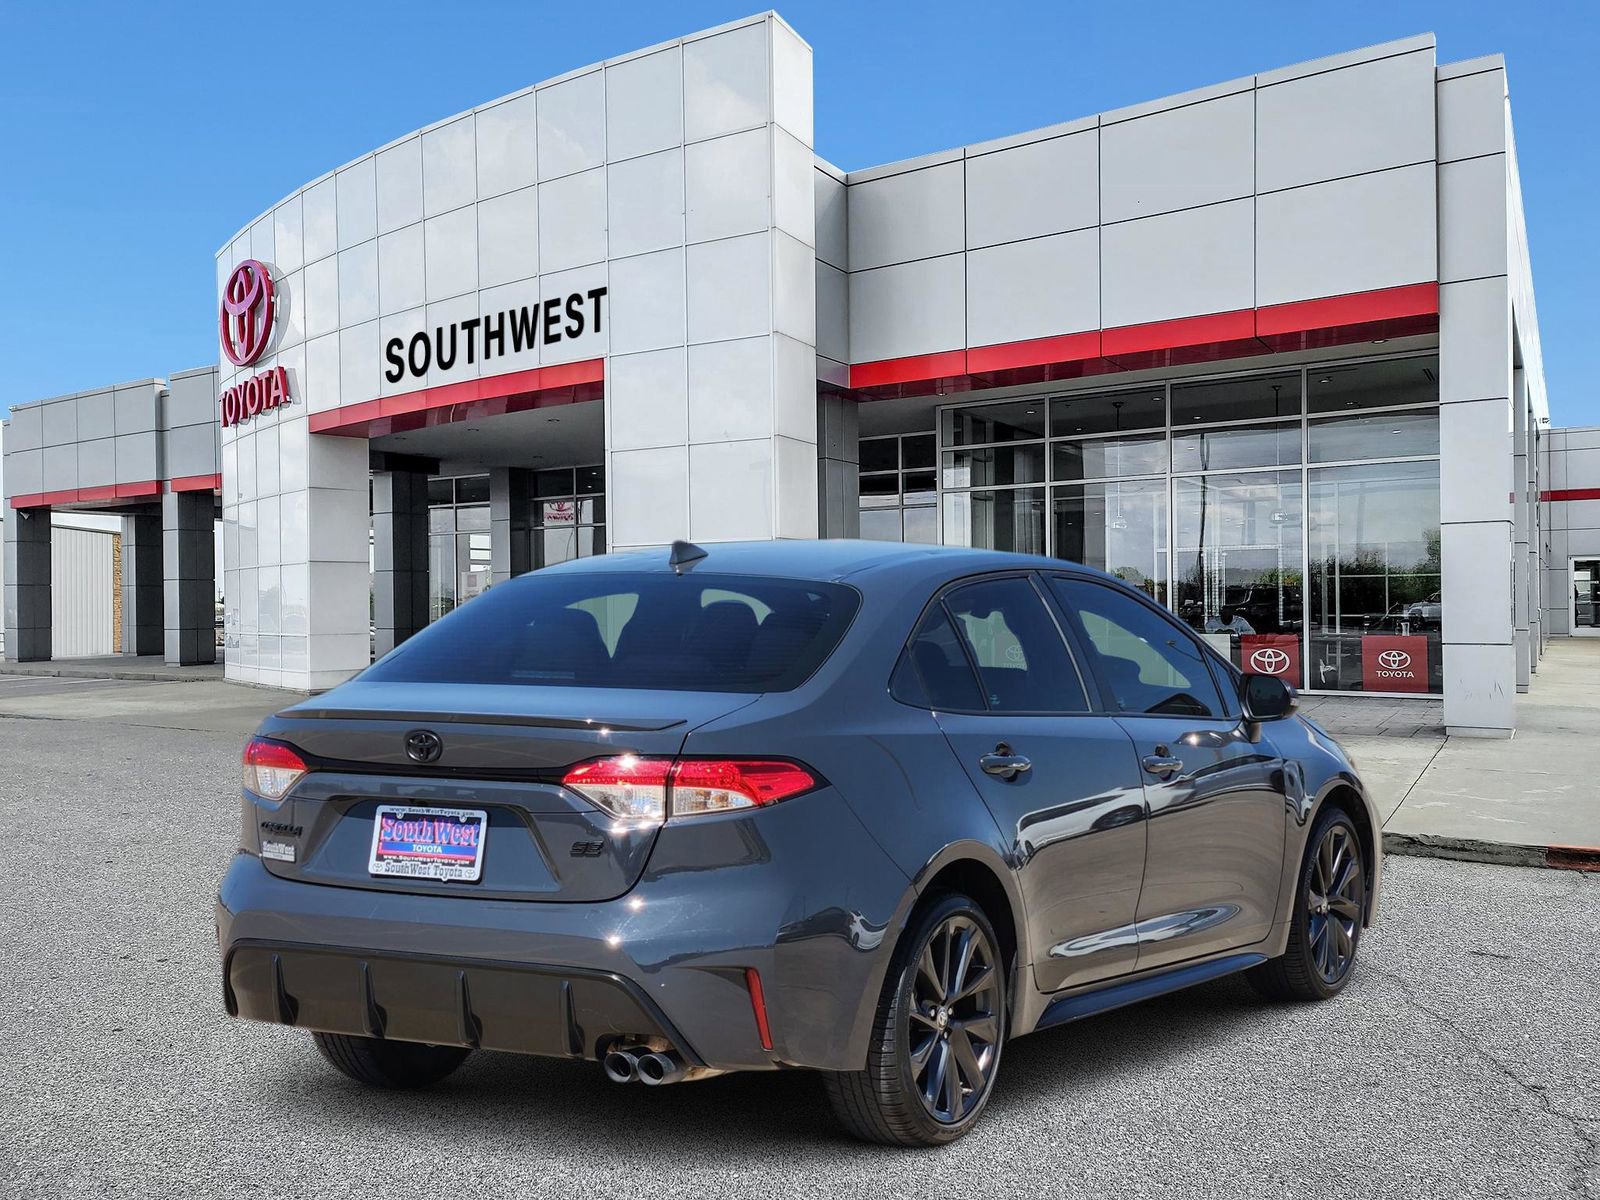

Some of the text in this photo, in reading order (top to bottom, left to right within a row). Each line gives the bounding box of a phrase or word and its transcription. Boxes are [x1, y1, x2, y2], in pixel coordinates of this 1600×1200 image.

[385, 287, 608, 384] SOUTHWEST
[219, 366, 289, 428] TOYOTA
[1375, 670, 1415, 678] TOYOTA
[412, 844, 443, 853] TOYOTA
[433, 865, 463, 878] Toyota
